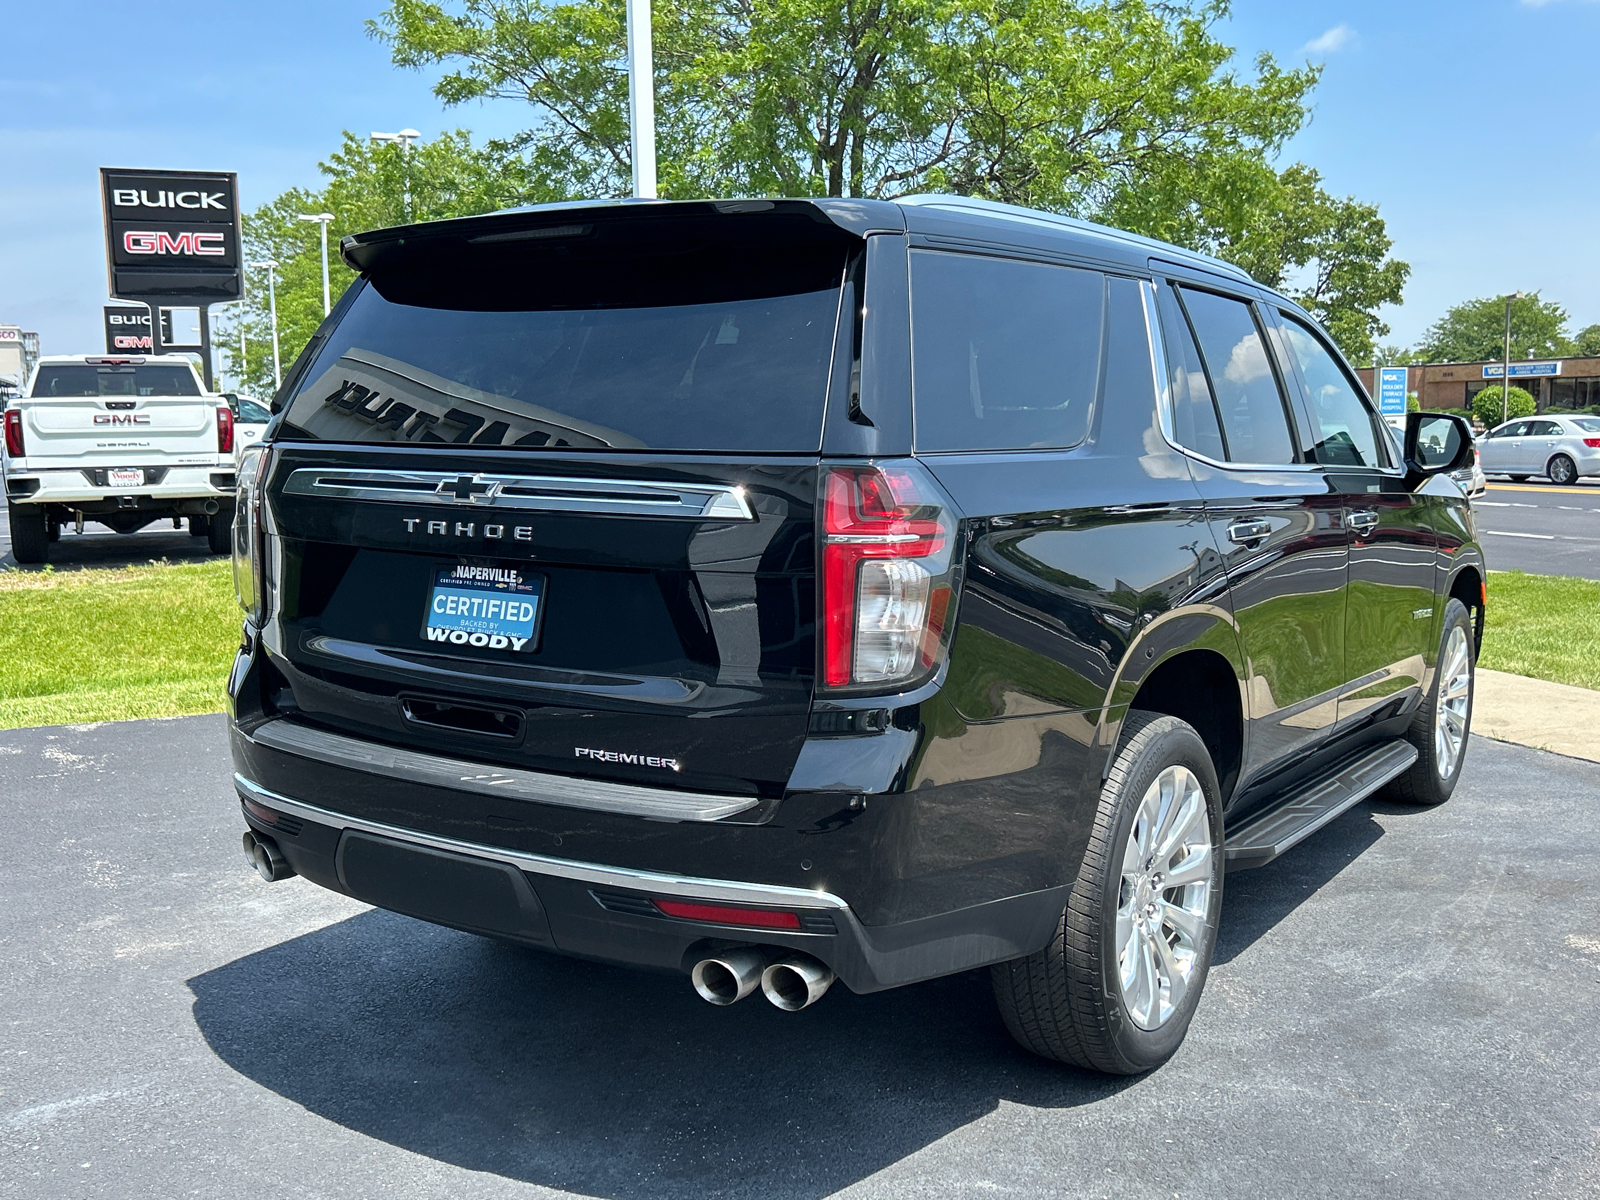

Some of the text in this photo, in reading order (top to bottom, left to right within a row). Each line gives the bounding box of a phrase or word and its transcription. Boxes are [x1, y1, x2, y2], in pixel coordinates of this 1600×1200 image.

[113, 189, 227, 210] BUICK
[124, 231, 225, 256] GMC
[0, 331, 16, 339] CO
[93, 415, 150, 425] GMC
[112, 472, 140, 480] Woody
[403, 518, 533, 541] TAHOE
[456, 565, 517, 583] NAPERVILLE
[433, 594, 534, 622] CERTIFIED
[460, 619, 488, 629] BACKED
[427, 627, 529, 651] WOODY
[574, 747, 680, 771] PREMIER
